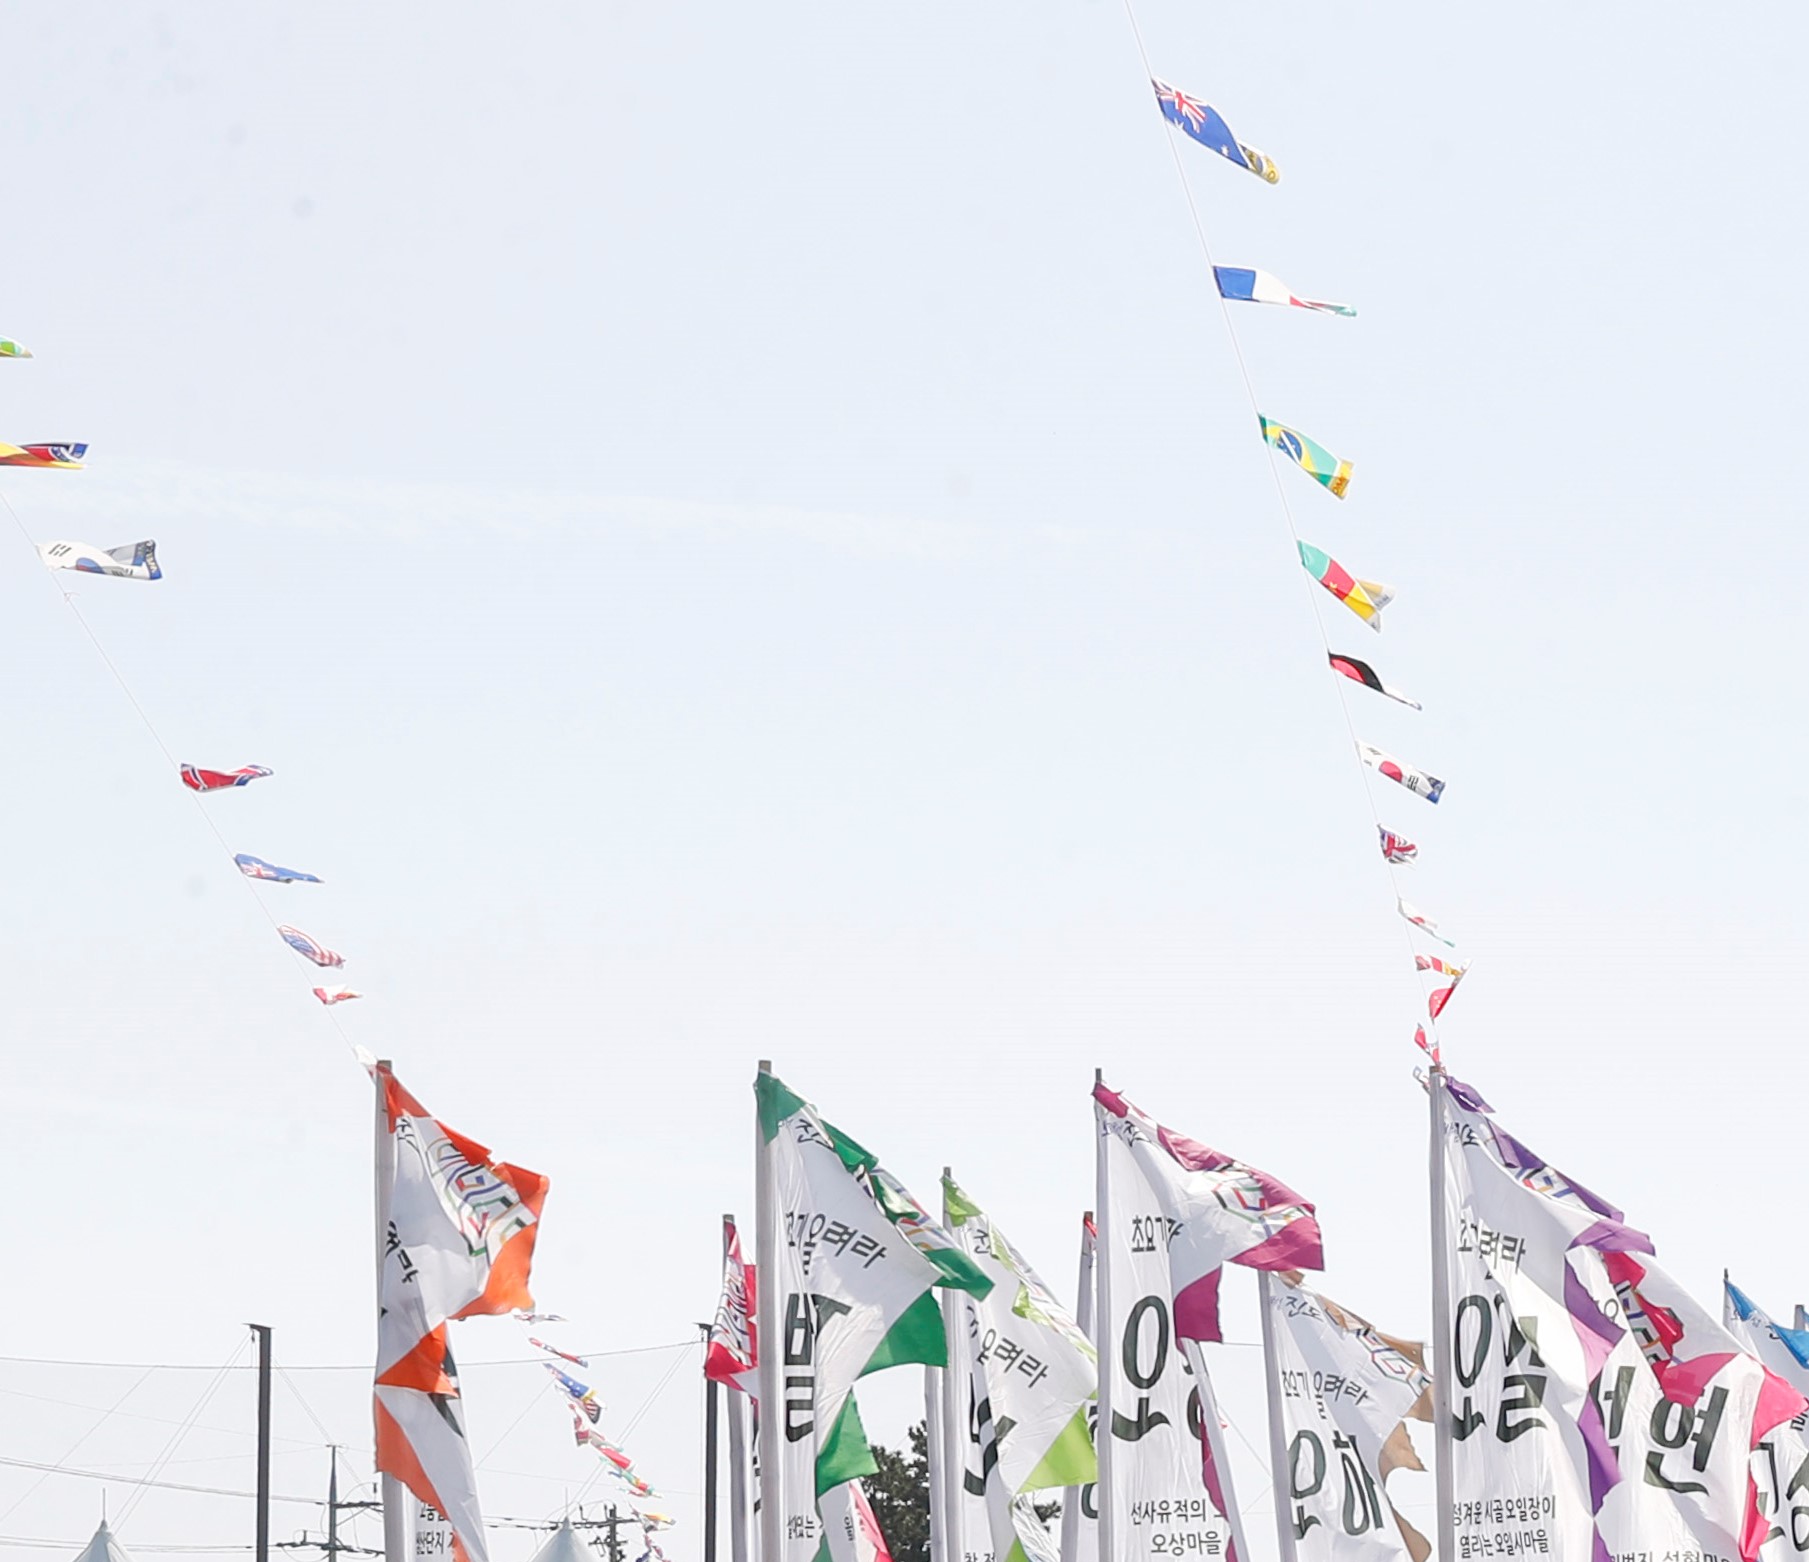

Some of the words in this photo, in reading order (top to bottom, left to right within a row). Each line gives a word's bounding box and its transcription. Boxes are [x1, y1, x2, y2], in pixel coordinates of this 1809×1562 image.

[1452, 1294, 1548, 1443] 오일
[1313, 1371, 1369, 1419] 올려라
[1288, 1429, 1384, 1541] 오하
[1132, 1499, 1206, 1525] 선사유적의
[1151, 1531, 1221, 1555] 오상마을
